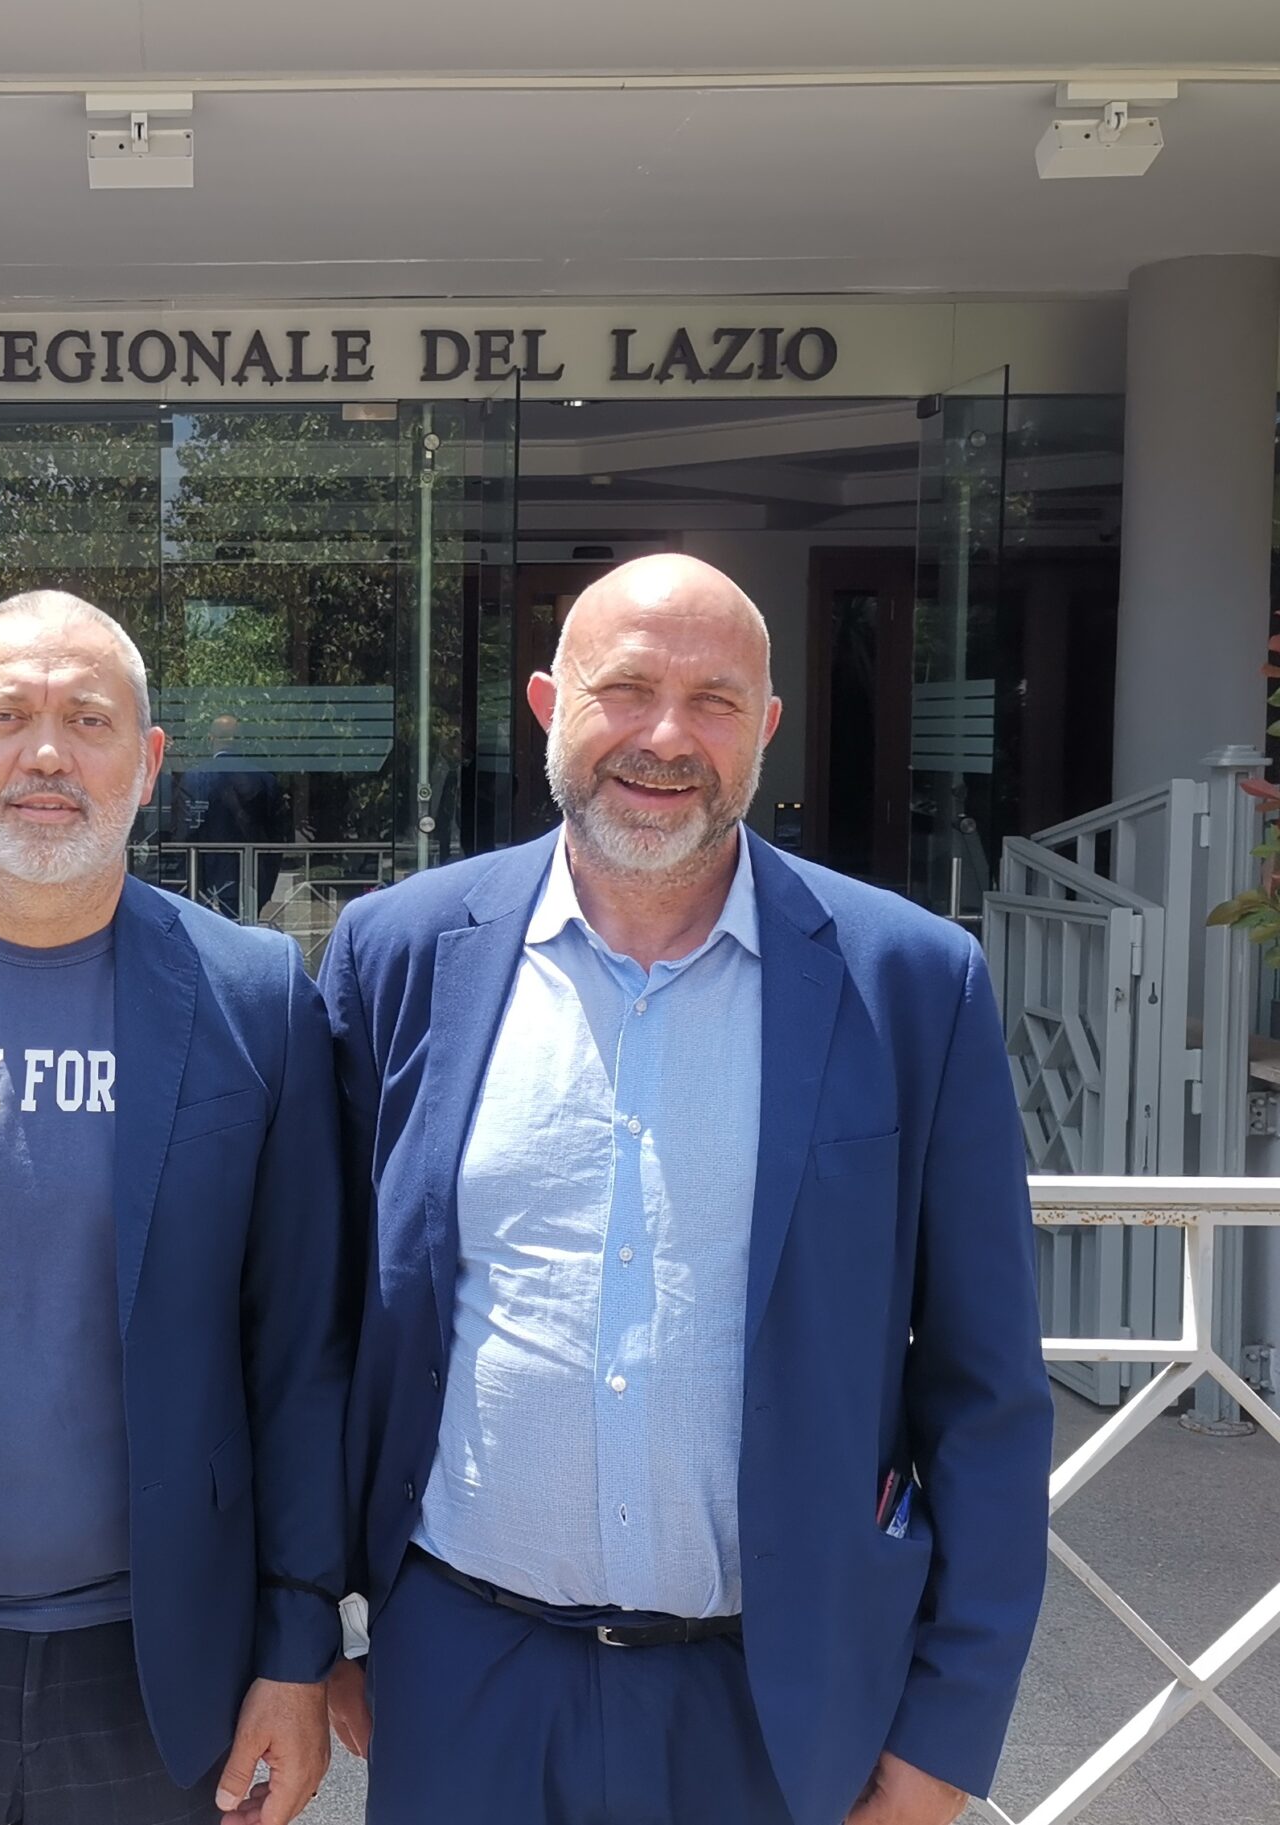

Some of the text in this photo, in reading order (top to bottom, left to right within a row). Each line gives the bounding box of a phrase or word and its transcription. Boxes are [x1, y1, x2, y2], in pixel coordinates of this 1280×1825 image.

[420, 328, 566, 383] DEL
[610, 326, 838, 385] LAZIO
[20, 1048, 116, 1112] FOR
